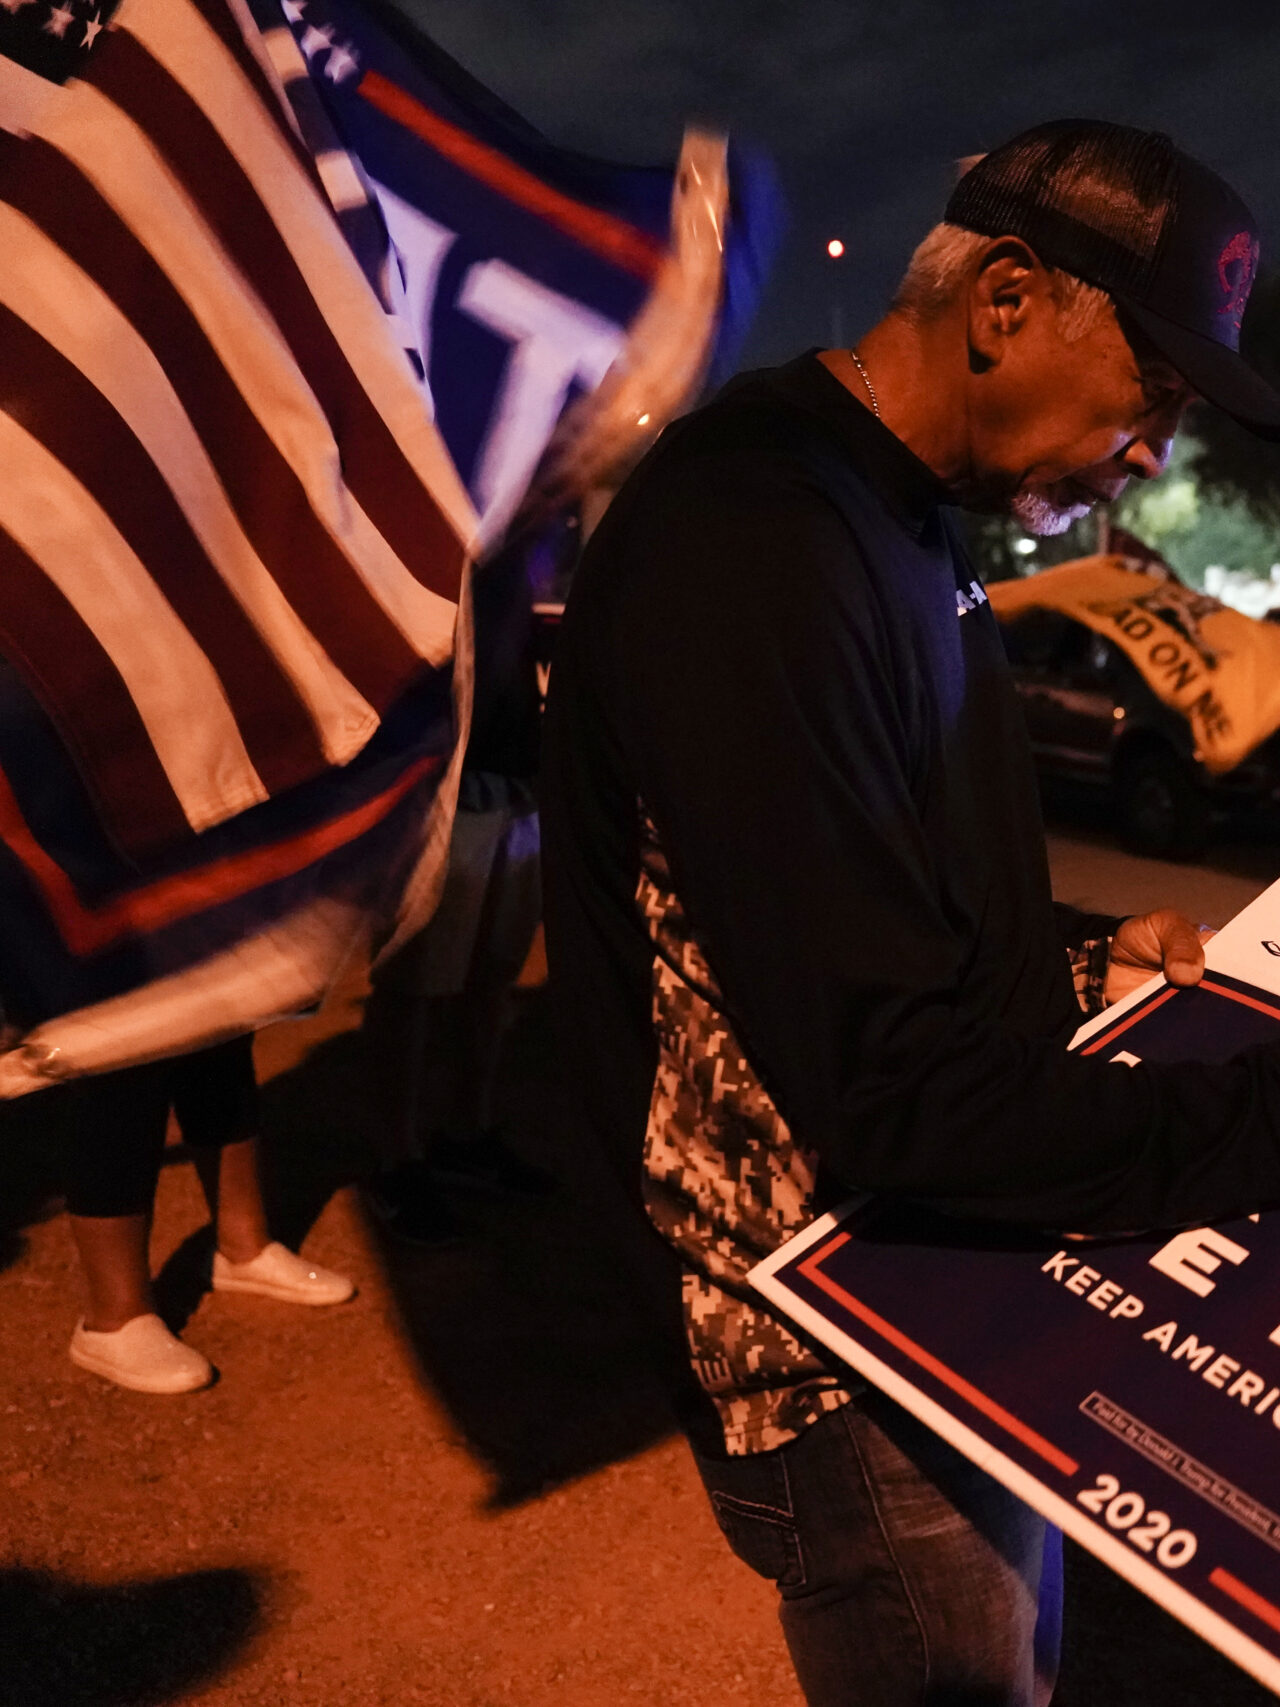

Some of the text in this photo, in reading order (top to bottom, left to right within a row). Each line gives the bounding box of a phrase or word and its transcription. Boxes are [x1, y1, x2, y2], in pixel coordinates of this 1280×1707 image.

[1150, 643, 1198, 692] ON
[1040, 1250, 1145, 1319] KEEP
[1076, 1473, 1198, 1569] 2020
